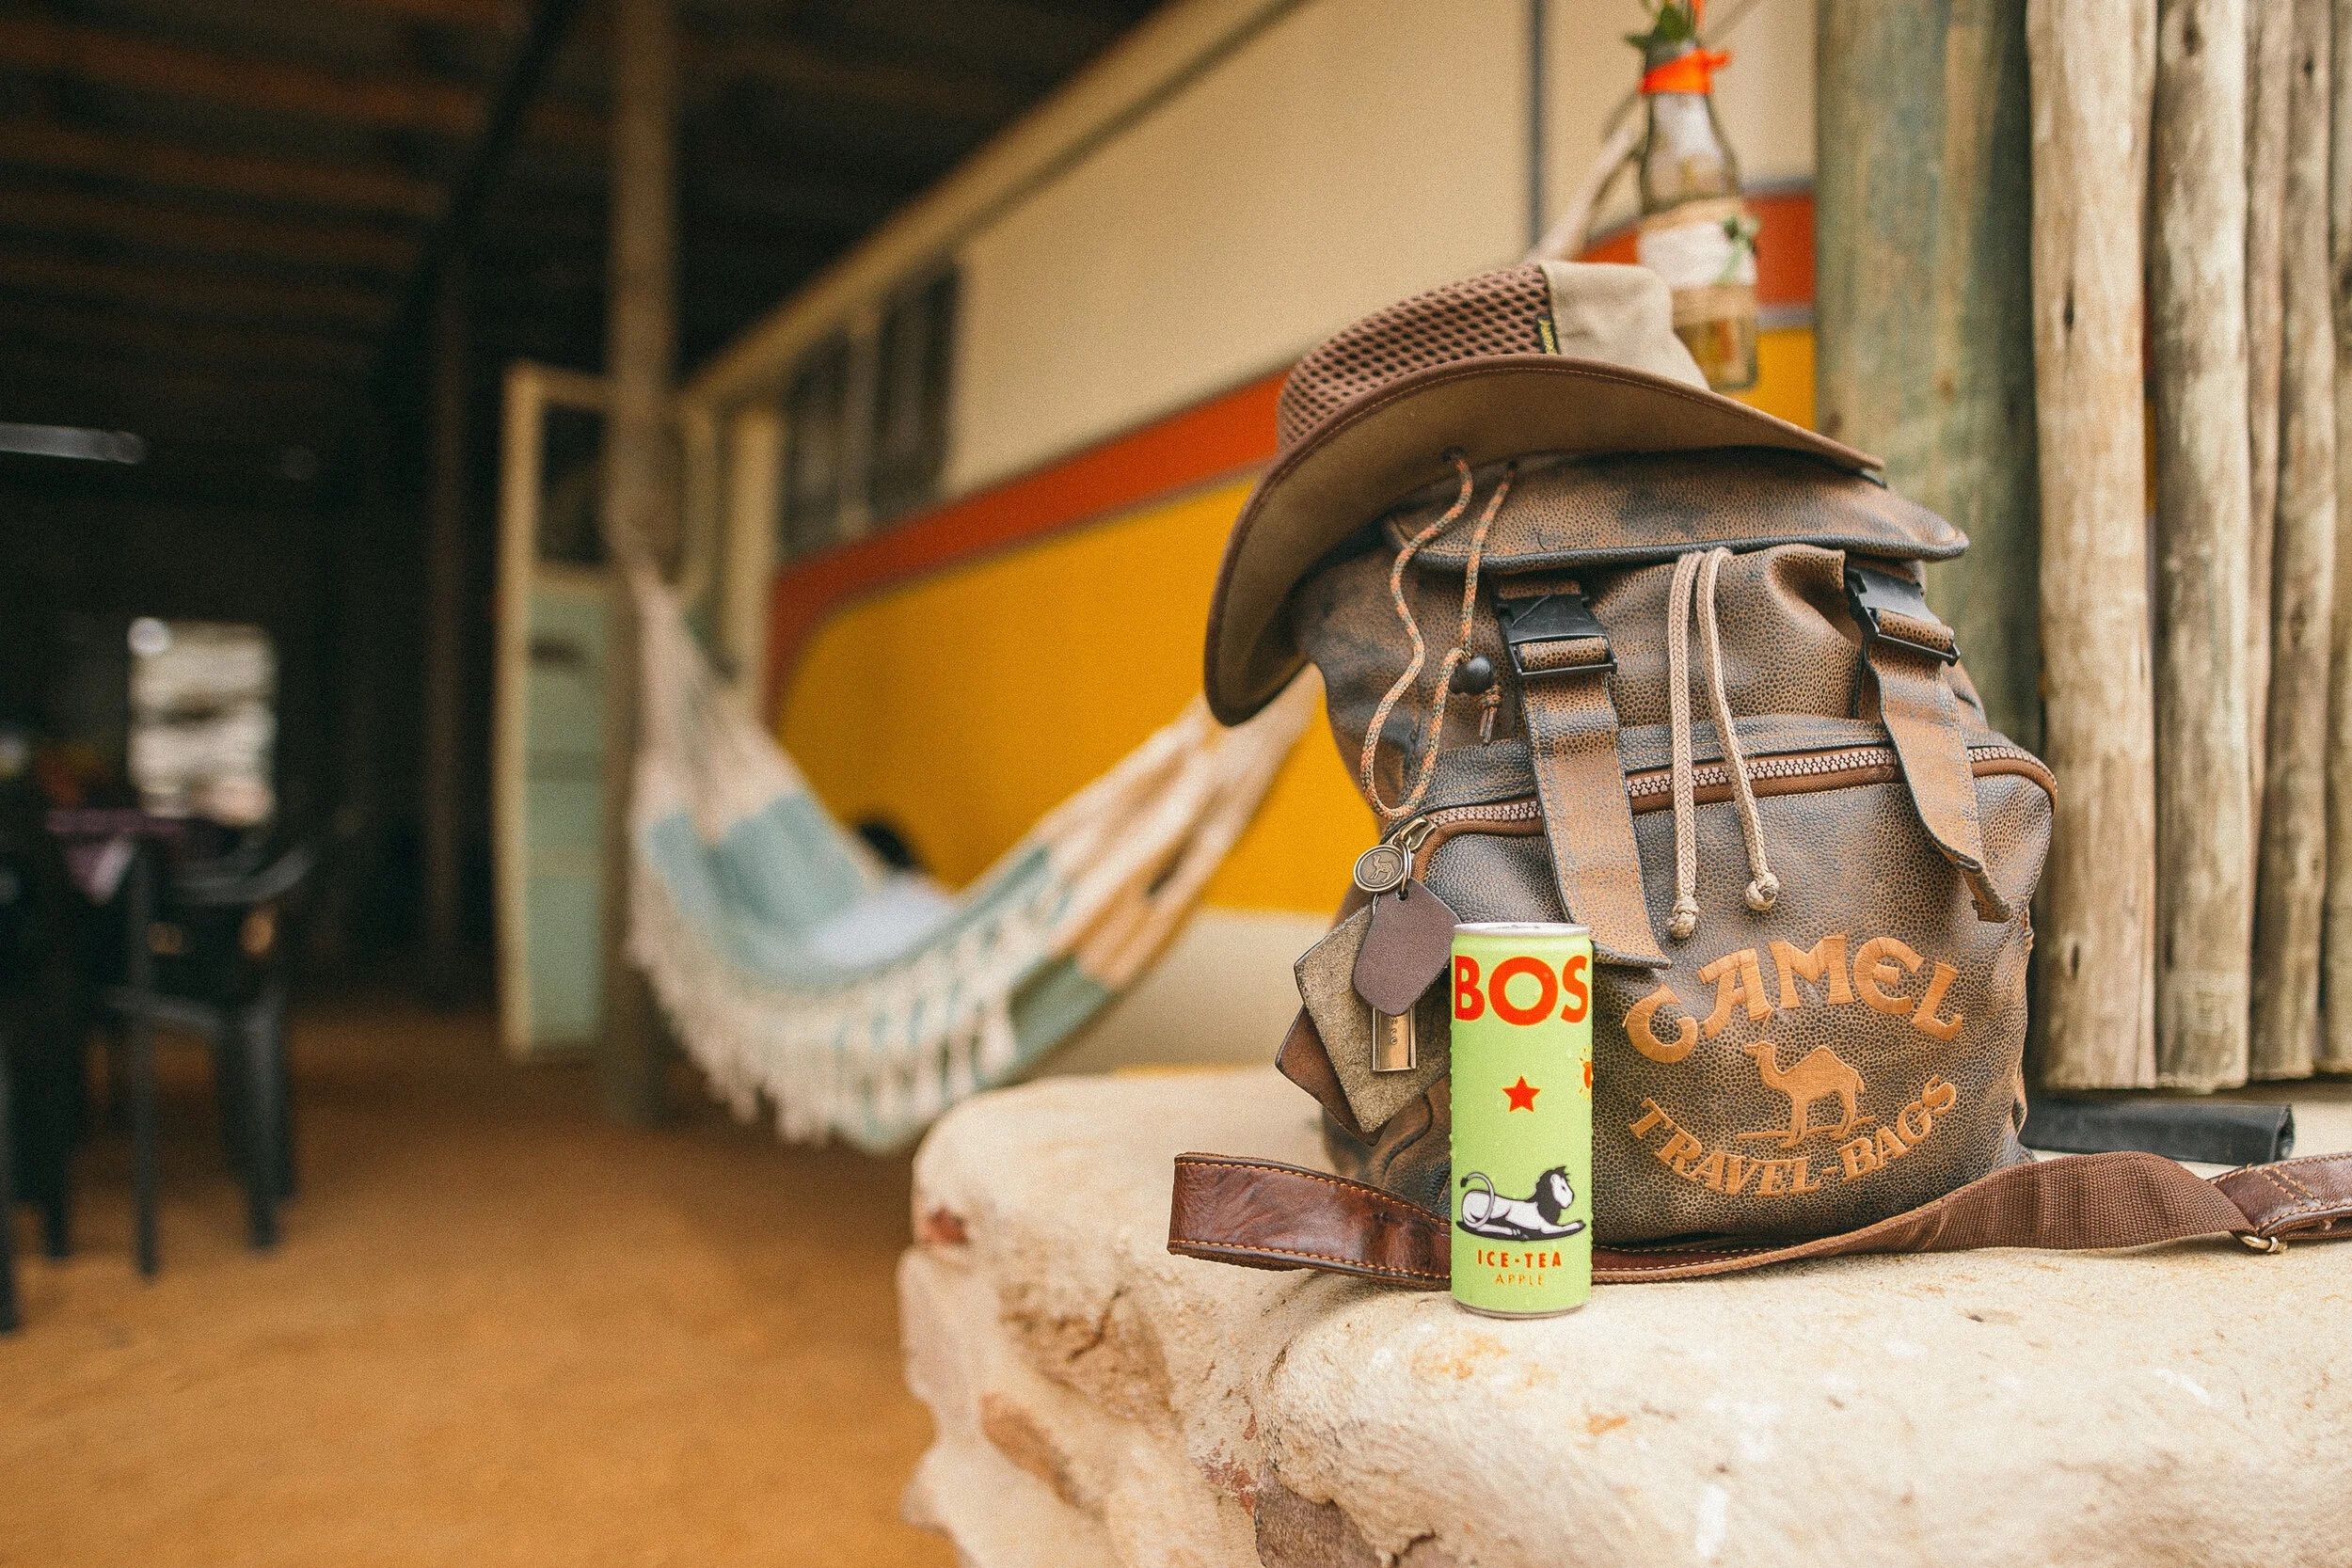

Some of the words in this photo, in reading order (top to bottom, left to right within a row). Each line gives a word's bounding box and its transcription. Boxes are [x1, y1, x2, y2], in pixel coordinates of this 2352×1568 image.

[1454, 955, 1589, 1027] BOS
[1626, 933, 1963, 1064] CAMEL
[1495, 1274, 1544, 1286] APPLE
